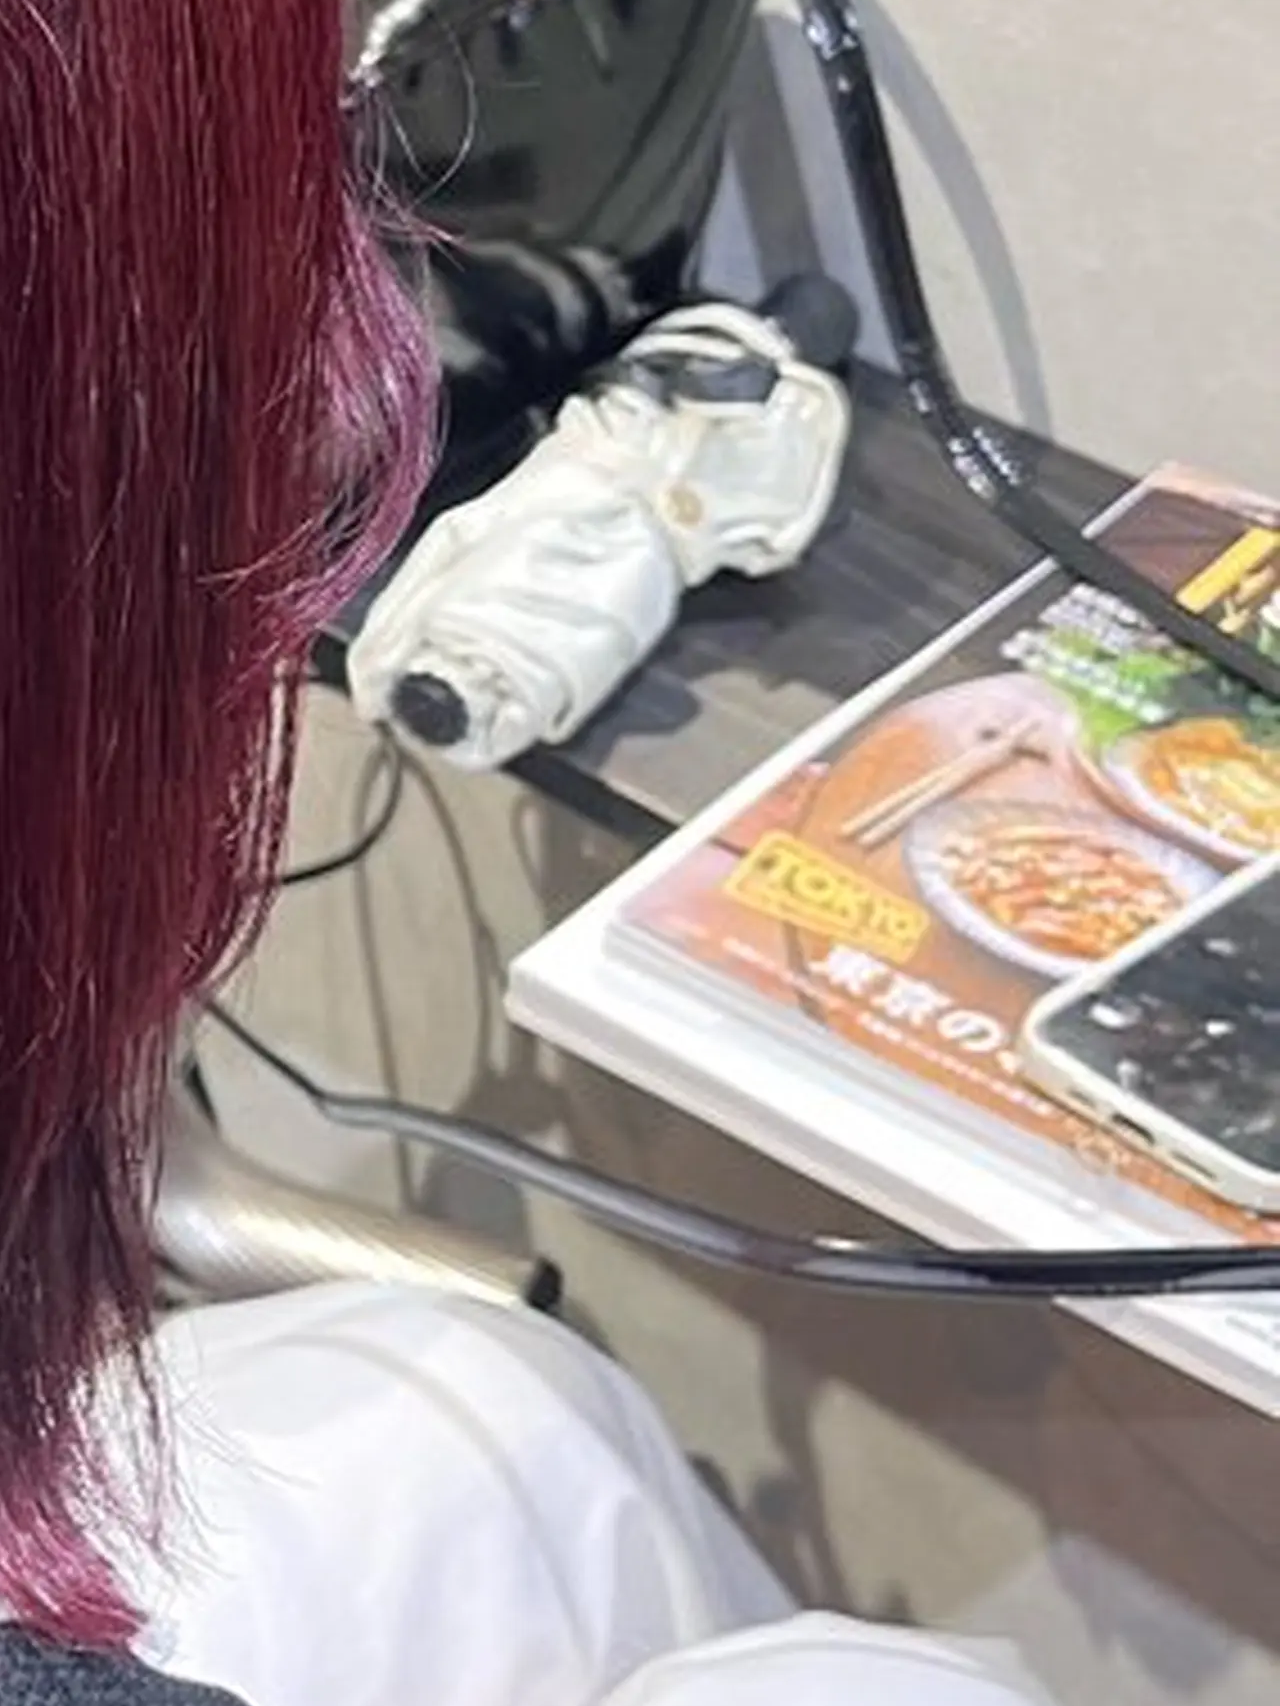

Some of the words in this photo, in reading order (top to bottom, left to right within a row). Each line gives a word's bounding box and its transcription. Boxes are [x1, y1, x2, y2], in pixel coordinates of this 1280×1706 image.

[767, 846, 921, 939] TOKYO
[808, 944, 1017, 1075] 東京の
